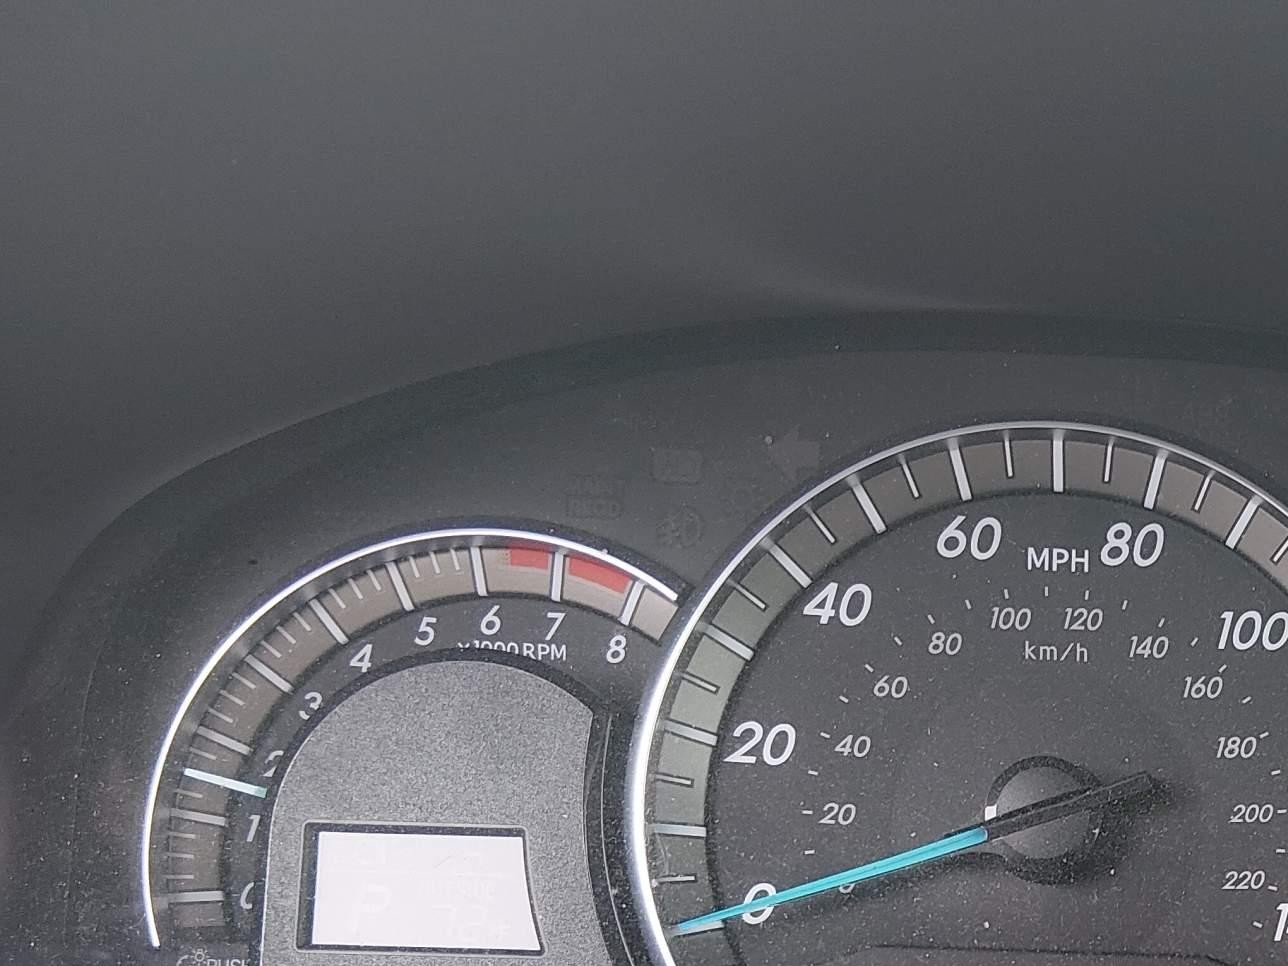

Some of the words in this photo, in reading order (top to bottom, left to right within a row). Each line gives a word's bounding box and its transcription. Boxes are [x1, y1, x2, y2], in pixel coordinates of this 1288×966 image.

[937, 516, 1001, 560] 60
[1101, 523, 1163, 566] 80
[1028, 547, 1088, 572] MPH
[803, 583, 871, 626] 40
[415, 617, 436, 645] 5
[481, 606, 500, 635] 6
[545, 612, 565, 640] 7
[991, 607, 1031, 630] 100
[1064, 608, 1102, 630] 120
[607, 635, 626, 663] 8
[929, 632, 962, 655] 80
[1025, 641, 1087, 661] km/h
[1130, 636, 1168, 658] 140
[350, 644, 372, 672] 4
[874, 676, 907, 698] 60
[1184, 676, 1222, 698] 160
[302, 692, 322, 720] 3
[724, 721, 795, 765] 20
[835, 735, 870, 757] 40
[1217, 737, 1256, 758] 180
[819, 803, 855, 825] 20
[1231, 805, 1273, 822] 200
[247, 815, 260, 842] 1
[1222, 871, 1265, 889] 220
[742, 883, 777, 925] 0
